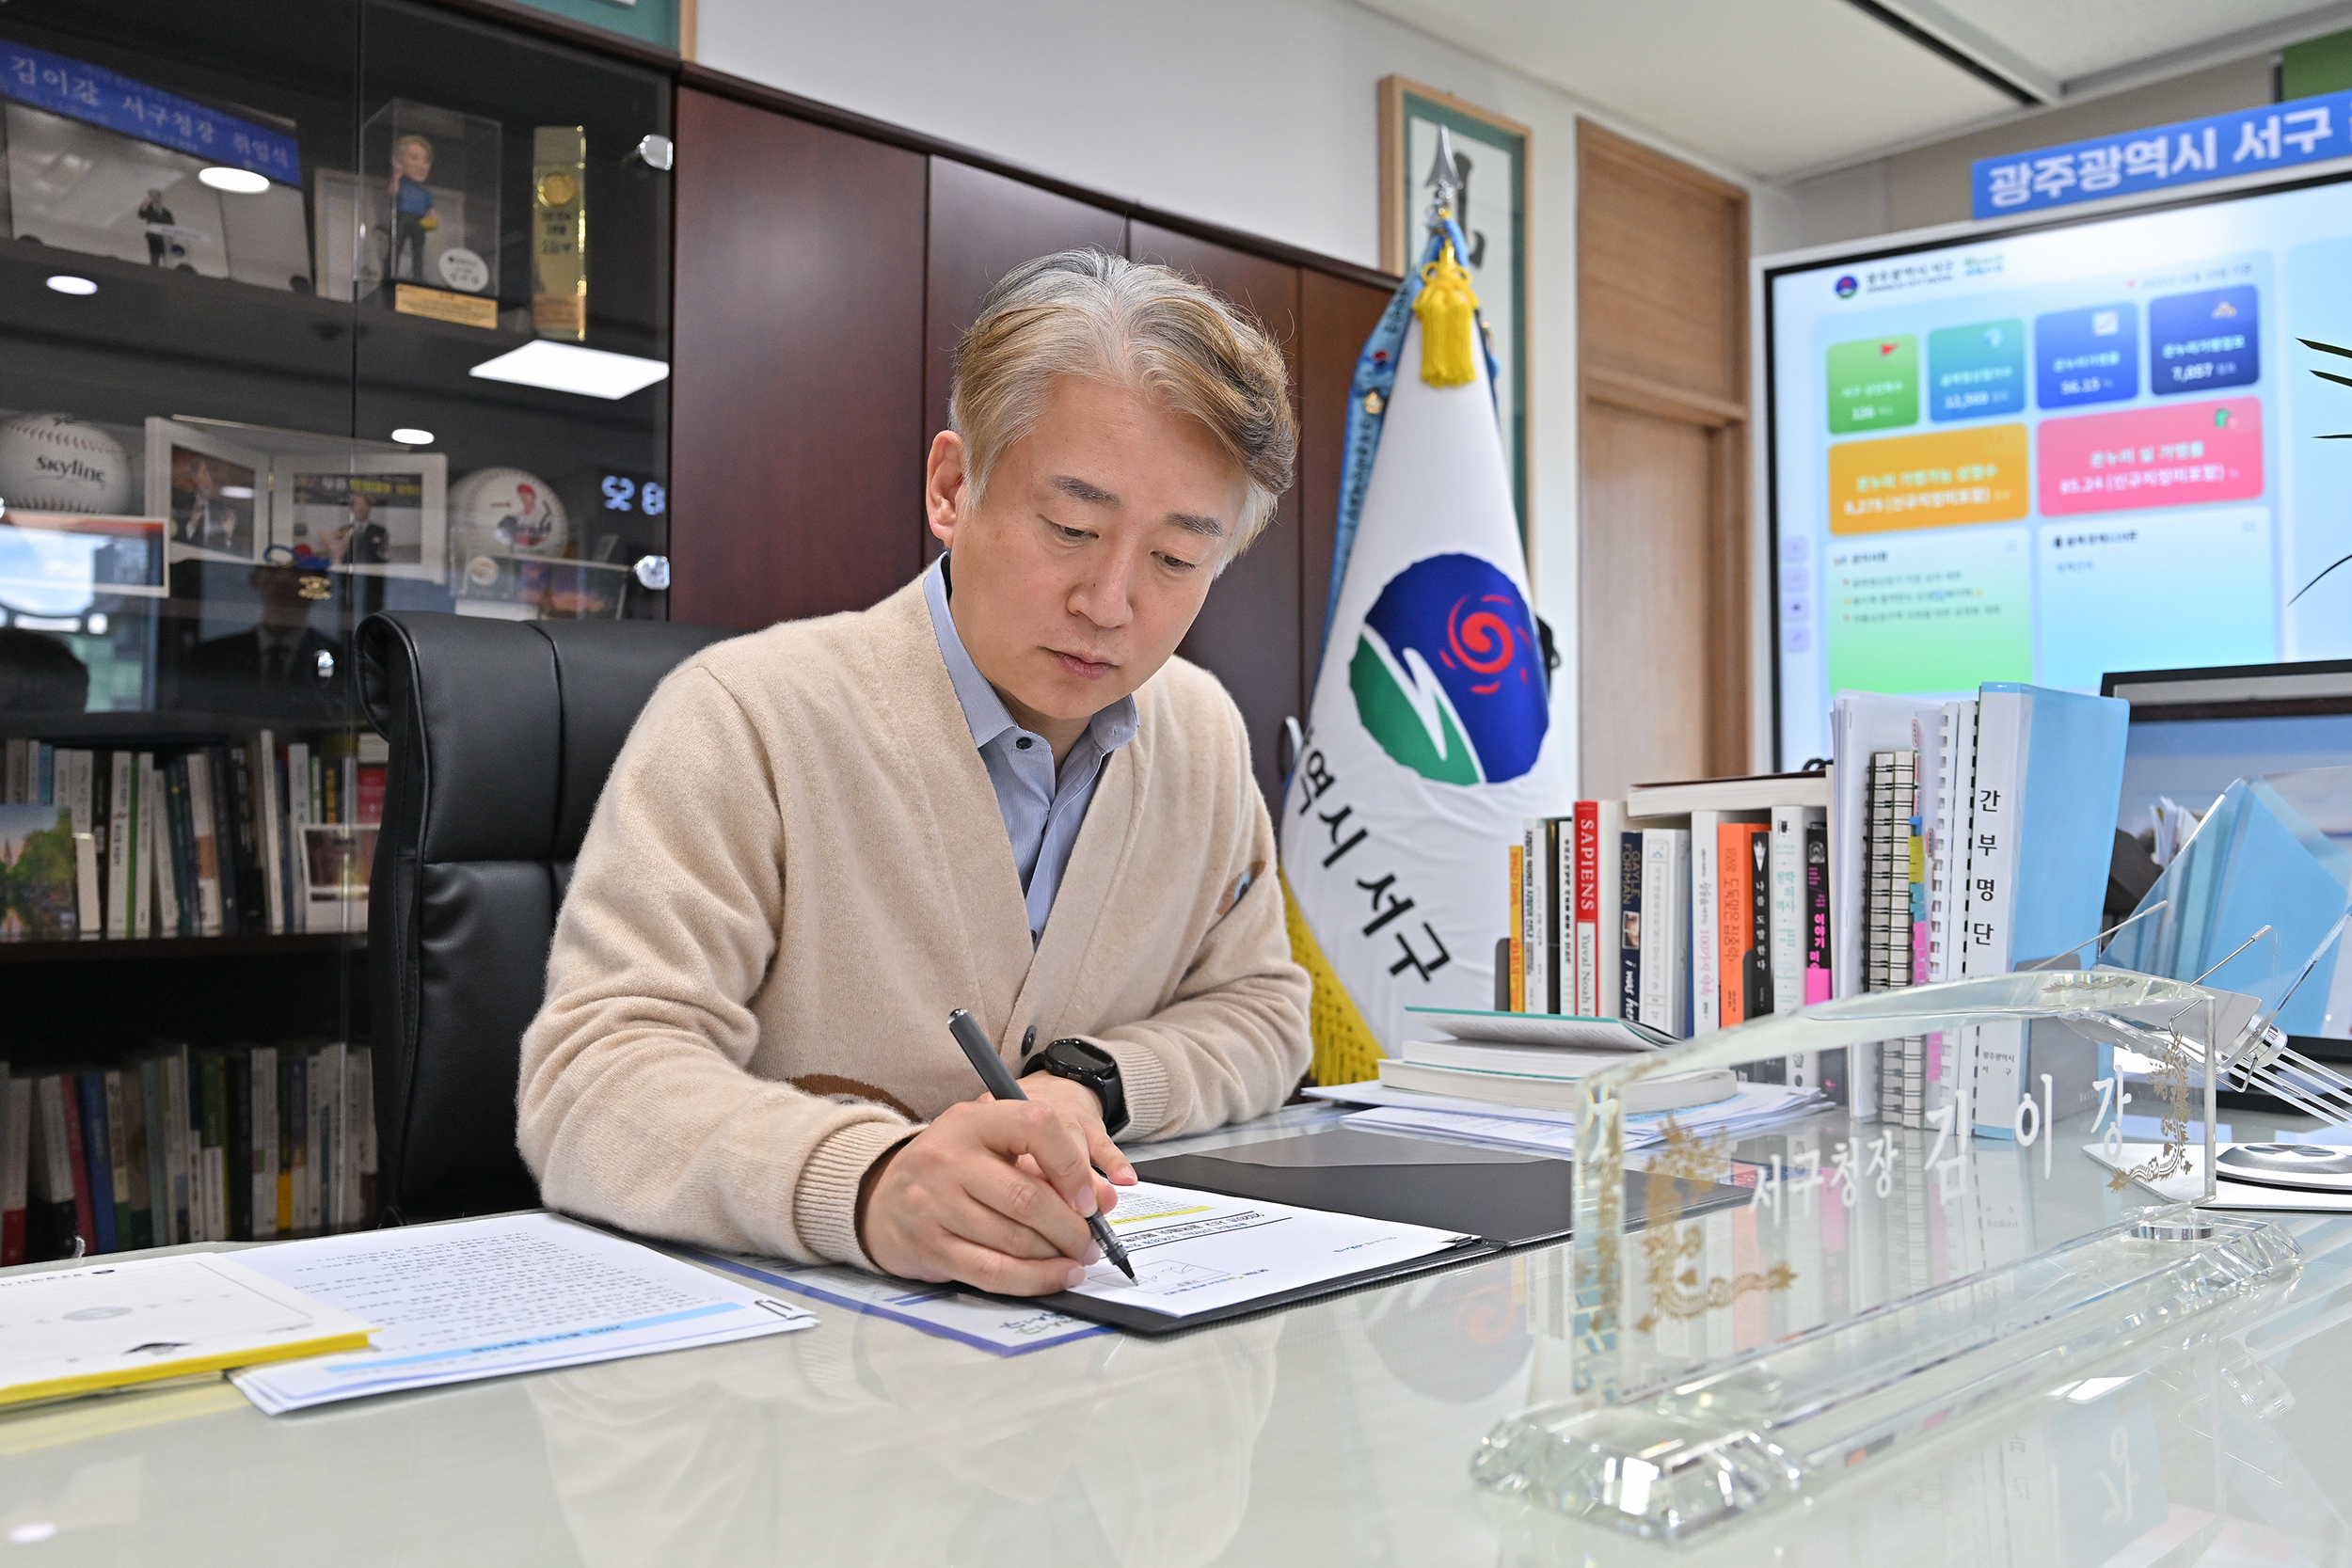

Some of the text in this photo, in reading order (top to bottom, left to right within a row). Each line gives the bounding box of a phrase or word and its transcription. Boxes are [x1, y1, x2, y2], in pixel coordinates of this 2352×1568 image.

[1988, 106, 2334, 208] 광주광역시 서구
[1299, 730, 1452, 984] 역시 서구
[1580, 817, 1596, 911] SAPIENS
[1622, 843, 1632, 906] FORMAN
[1632, 849, 1642, 897] GAYLE
[1775, 871, 1796, 889] 철학
[1581, 934, 1591, 968] Yuval
[1724, 878, 1740, 962] 도둑맞은 집중력
[1814, 913, 1825, 949] 이야기
[1581, 970, 1591, 1001] Noah
[1623, 958, 1639, 1022] i was her
[1982, 1051, 2015, 1063] 광주광역시
[1749, 1129, 1900, 1227] 서구청장
